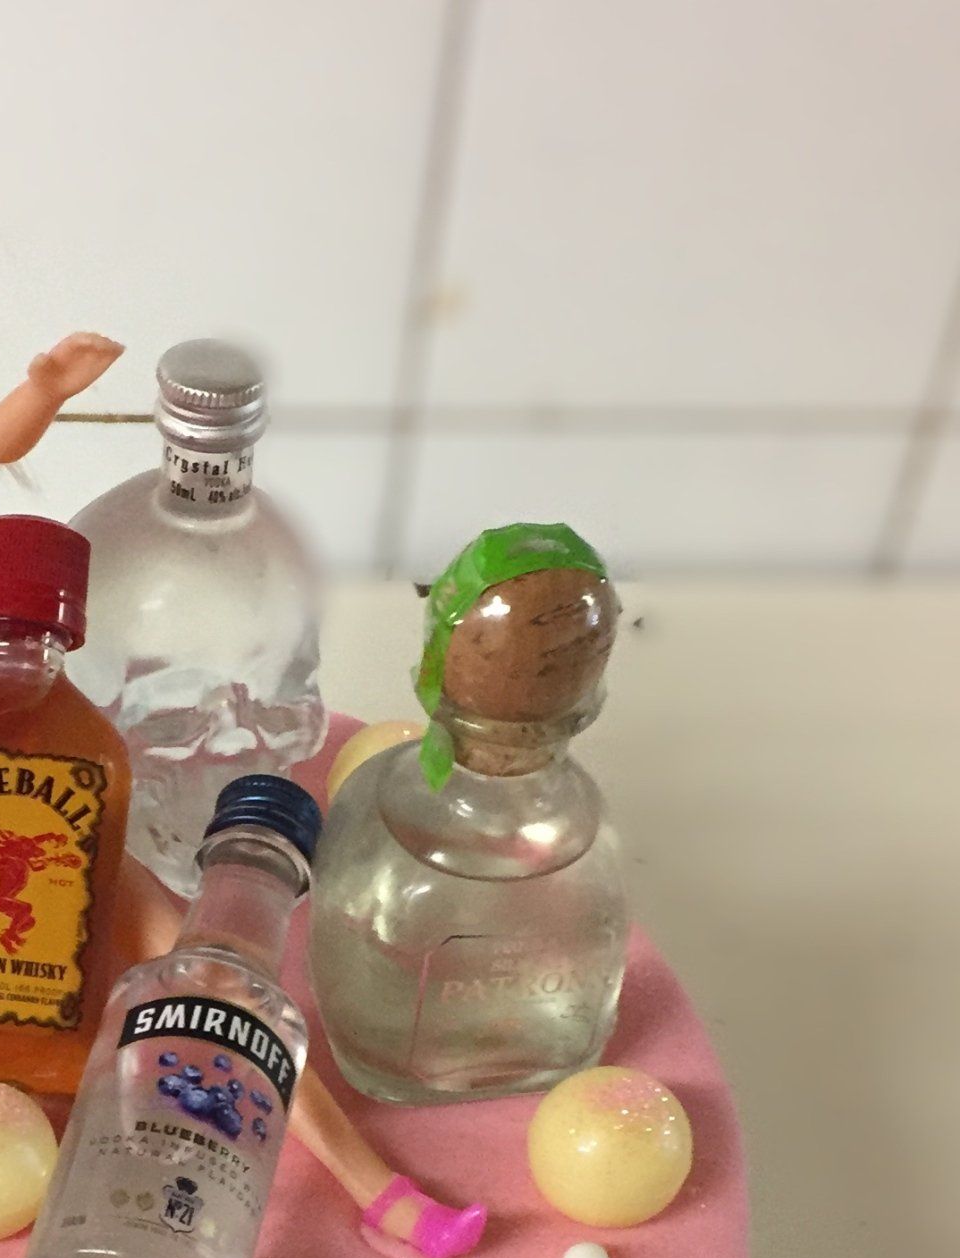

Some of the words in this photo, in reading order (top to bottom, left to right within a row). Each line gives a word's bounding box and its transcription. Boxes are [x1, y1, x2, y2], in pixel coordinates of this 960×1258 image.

[165, 446, 229, 476] Crystal
[48, 878, 74, 887] HOT
[11, 959, 67, 981] WHISKY
[134, 1003, 290, 1084] SMIRNOFF
[89, 1134, 149, 1146] VODKA
[135, 1121, 250, 1173] BLUEBERRY
